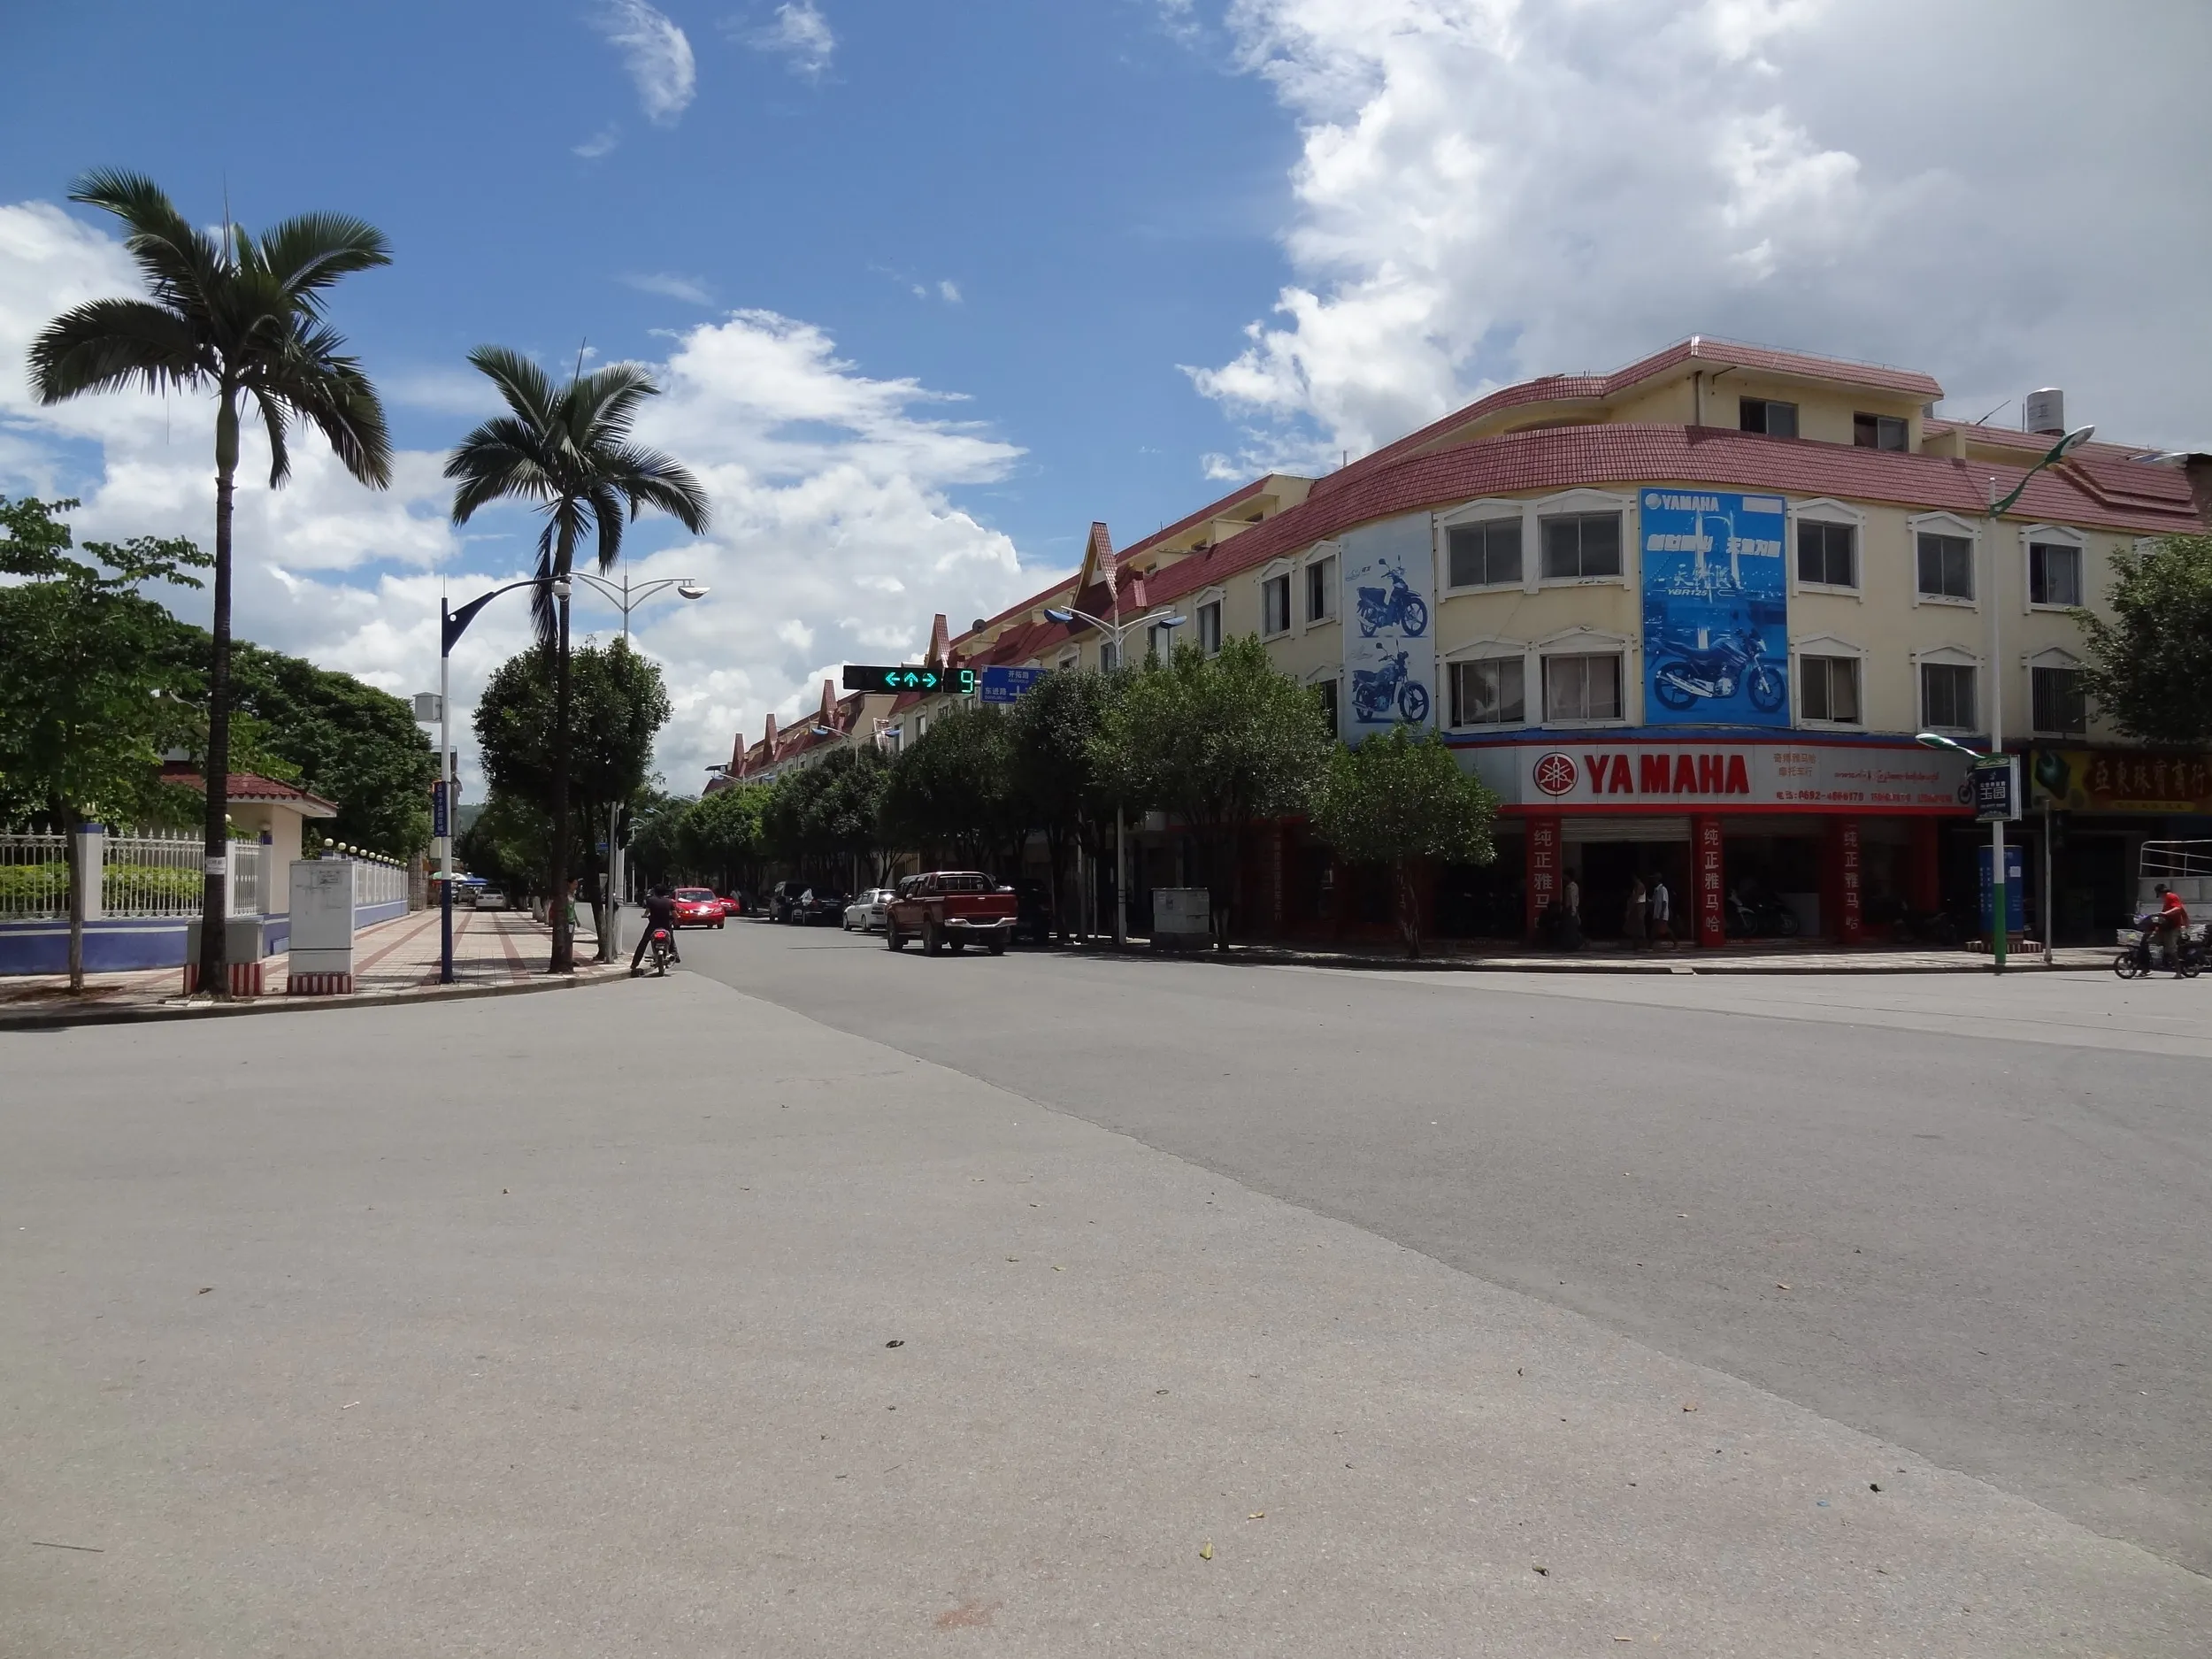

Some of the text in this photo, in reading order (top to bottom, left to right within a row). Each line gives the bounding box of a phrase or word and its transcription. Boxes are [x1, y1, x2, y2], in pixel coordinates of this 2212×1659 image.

[1663, 495, 1719, 511] YAMAHA
[960, 671, 973, 692] 9
[1584, 754, 1750, 794] YAMAHA
[1533, 829, 1553, 928] 纯正雅马
[1704, 828, 1719, 933] 纯正雅马哈
[1844, 832, 1859, 930] 纯正雅马哈
